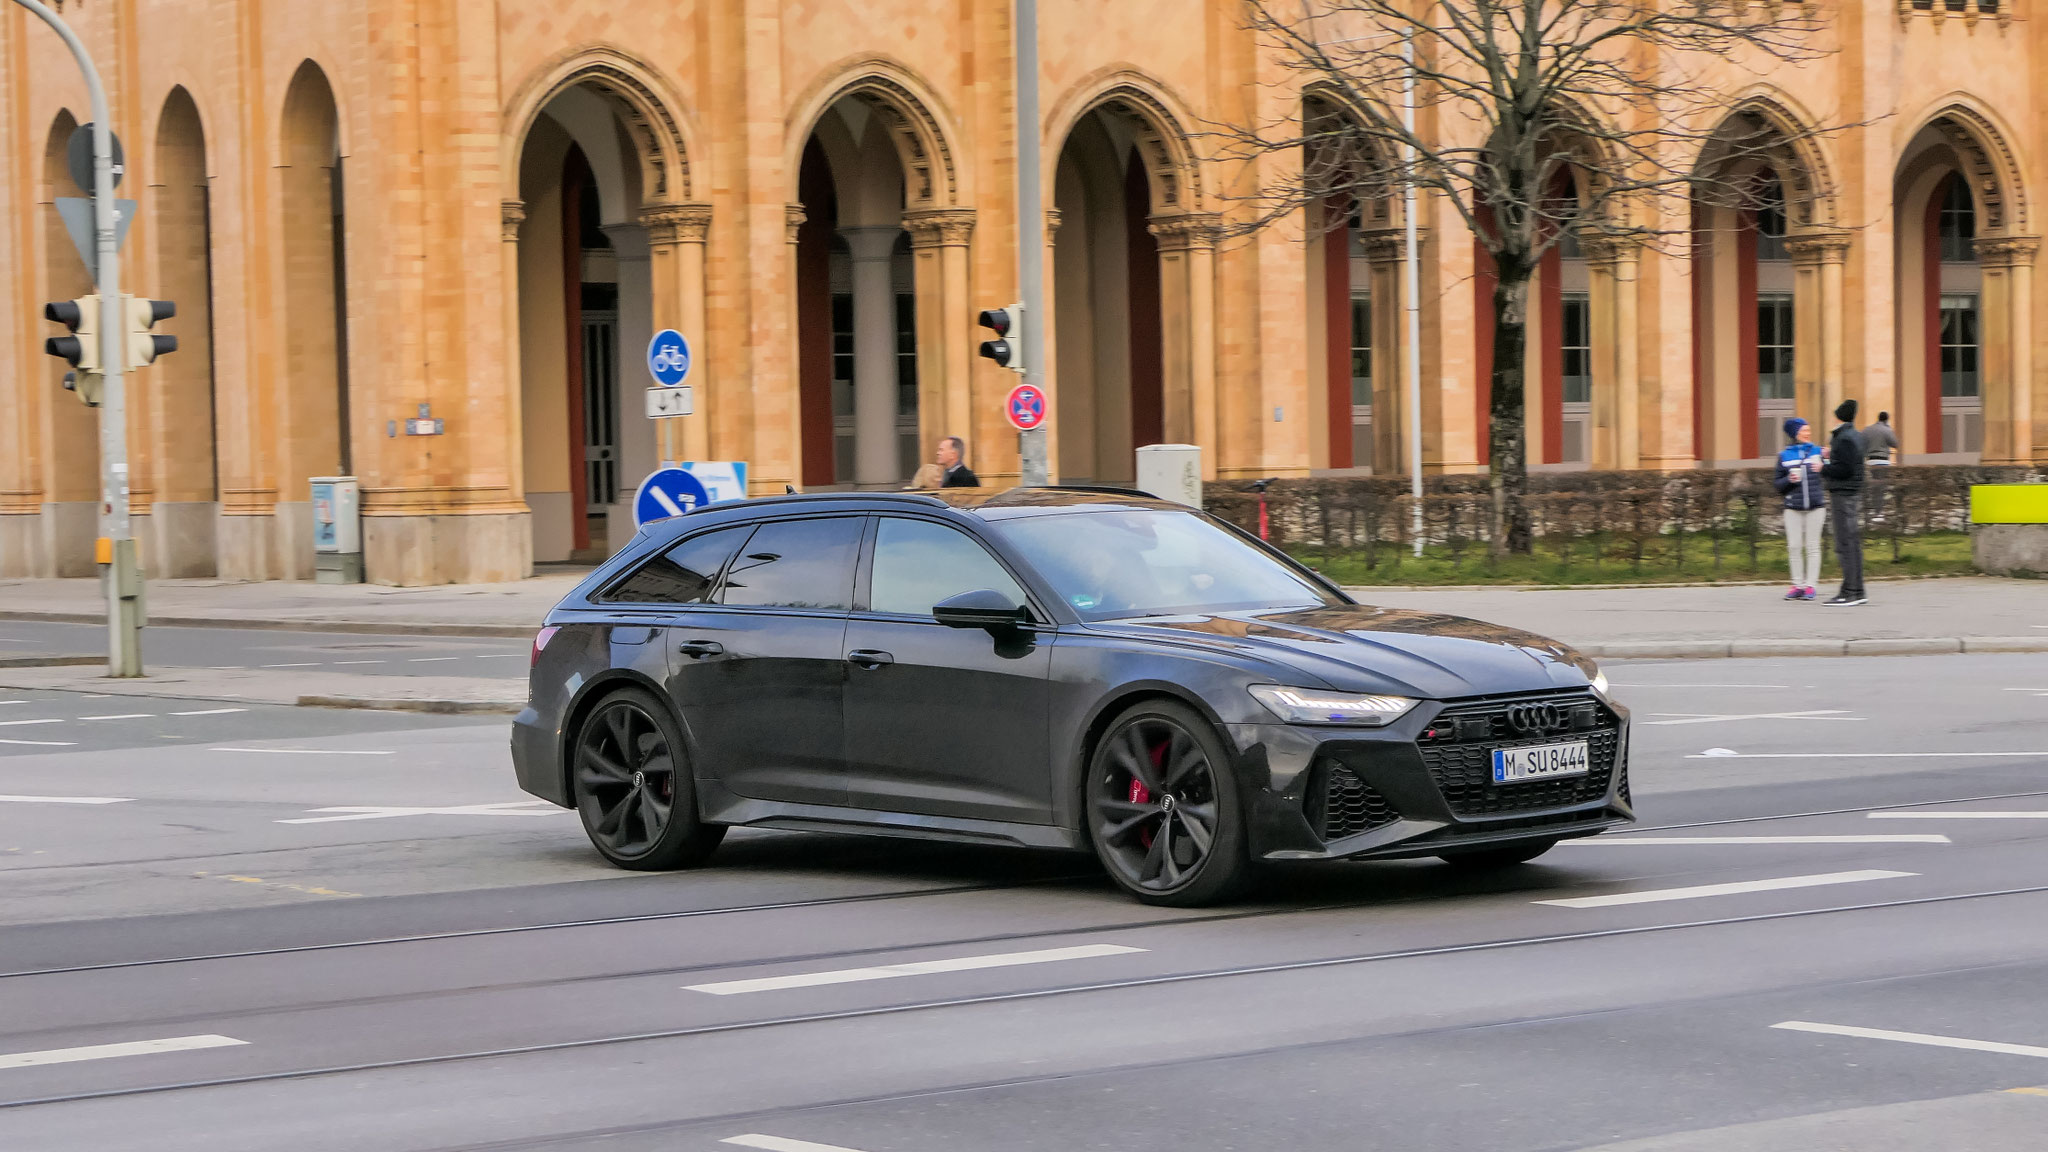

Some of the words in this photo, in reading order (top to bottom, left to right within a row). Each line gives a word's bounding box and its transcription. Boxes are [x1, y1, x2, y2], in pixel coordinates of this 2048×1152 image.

[1505, 753, 1516, 776] M
[1527, 750, 1548, 774] SU
[1550, 746, 1585, 771] 8444
